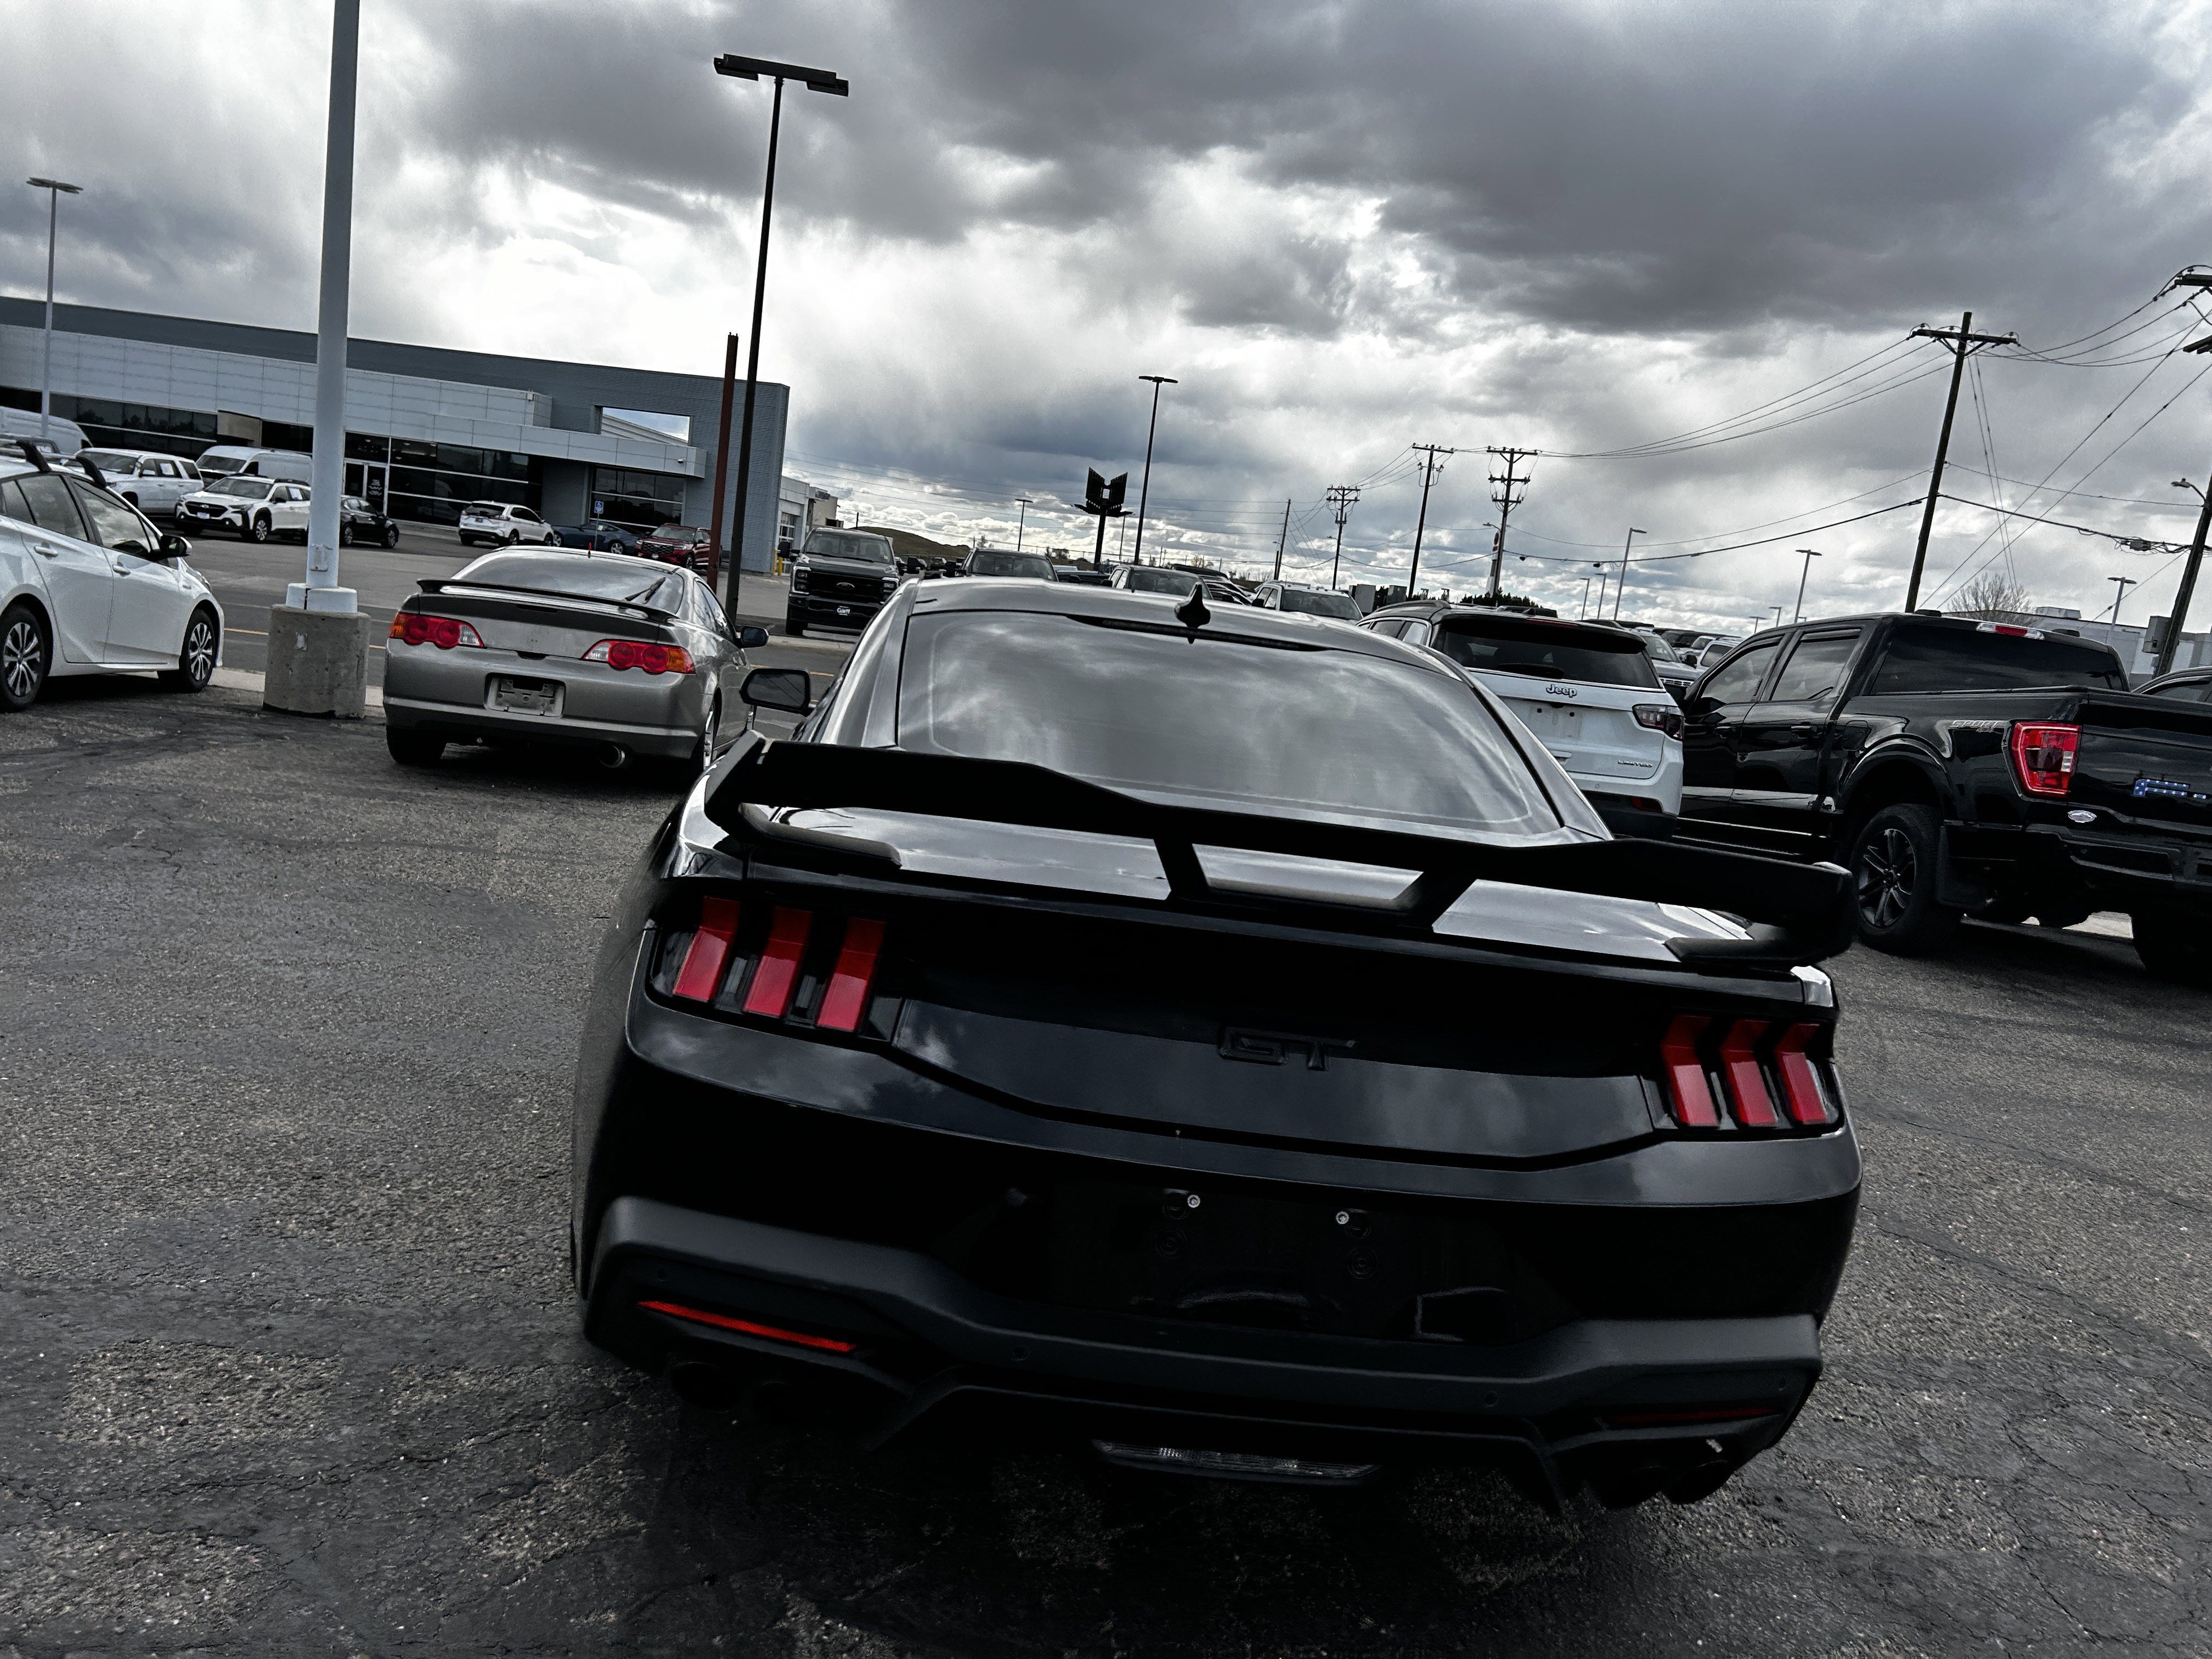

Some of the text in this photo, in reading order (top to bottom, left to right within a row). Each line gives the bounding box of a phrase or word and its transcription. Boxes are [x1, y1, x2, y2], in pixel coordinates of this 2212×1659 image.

[1546, 684, 1577, 698] Jeep
[1949, 720, 2001, 729] SPORT
[1218, 1026, 1360, 1071] GT
